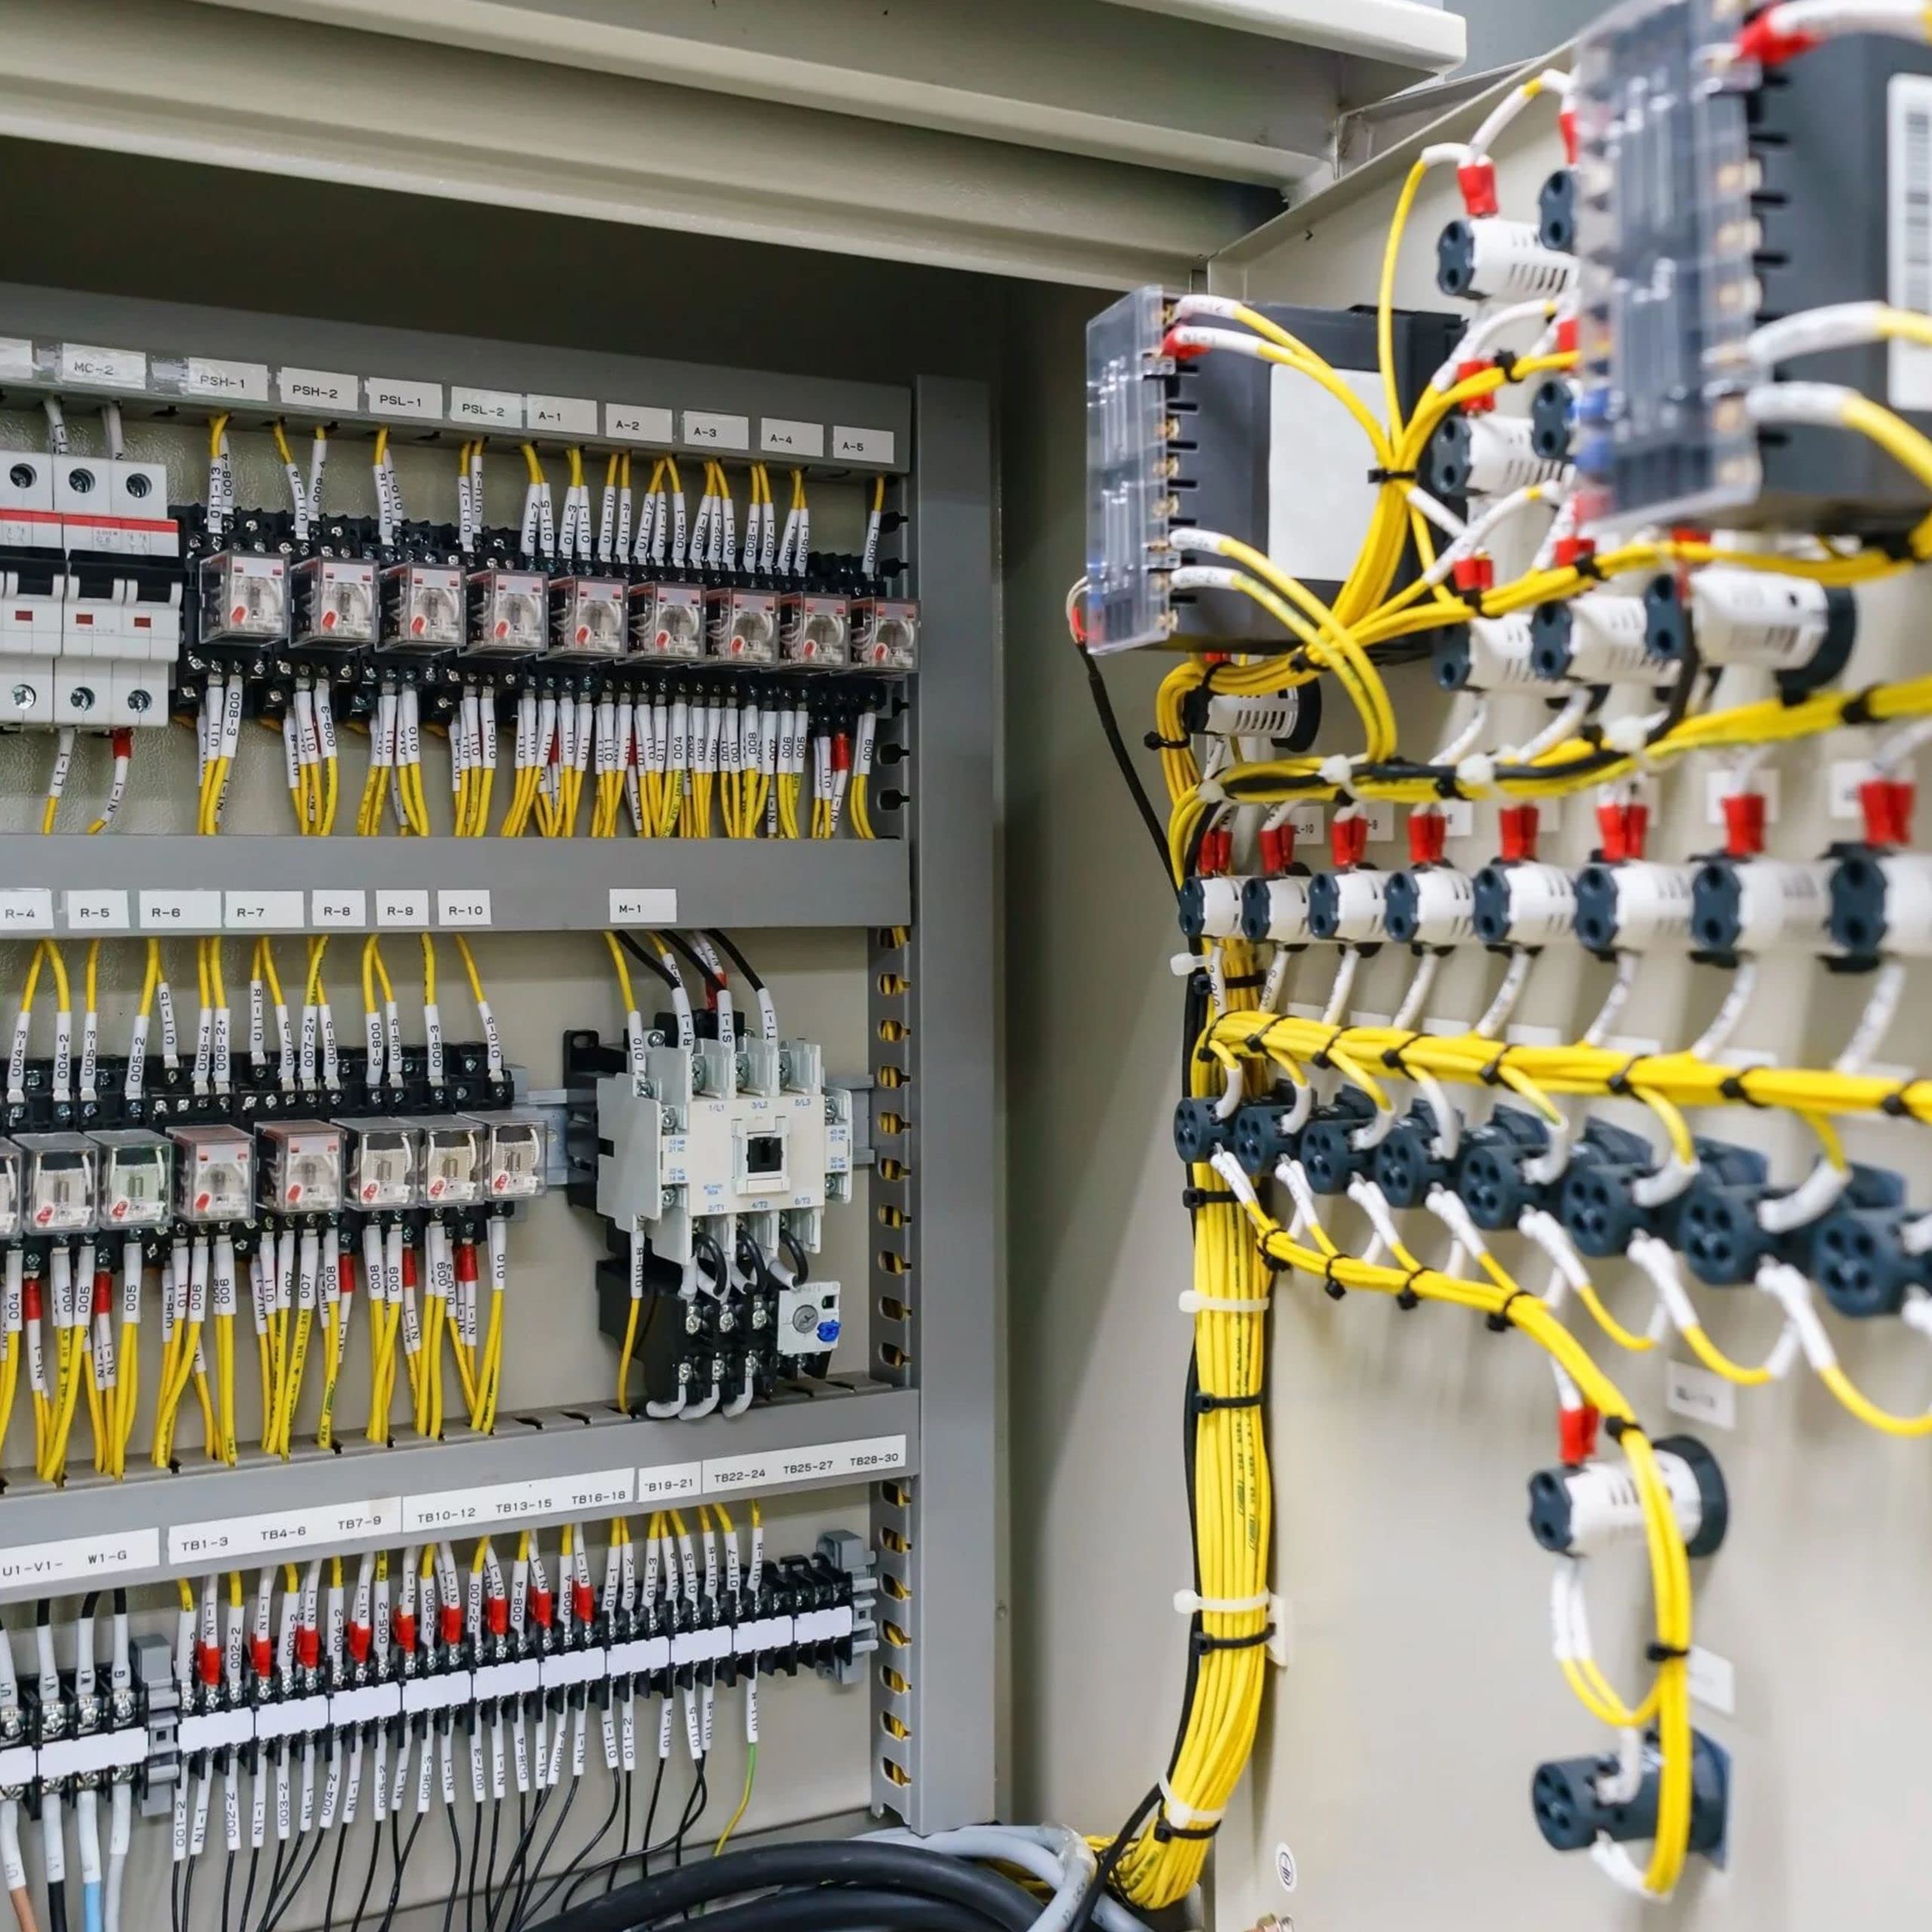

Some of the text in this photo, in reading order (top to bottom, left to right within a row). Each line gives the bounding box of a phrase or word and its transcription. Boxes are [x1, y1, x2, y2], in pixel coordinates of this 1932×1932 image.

[74, 361, 114, 376] MC-2
[199, 374, 246, 389] PSH-1
[292, 383, 338, 399] PSH-2
[379, 394, 422, 408] PSL-1
[461, 403, 505, 418] PSL-2
[538, 411, 561, 423] A-1
[616, 420, 640, 431] A-2
[693, 427, 717, 438] A-3
[770, 433, 792, 445] A-4
[842, 441, 865, 452] A-5
[221, 454, 232, 497] 008-4
[387, 470, 402, 510] 010-1
[211, 466, 221, 518] 011-13
[528, 502, 539, 543] 011-7
[540, 500, 552, 541] 011-5
[564, 504, 577, 545] 011-3
[580, 505, 590, 543] 011-1
[694, 512, 709, 549] 003-1
[727, 518, 735, 555] 001-1
[746, 519, 758, 558] 008-1
[765, 518, 774, 558] 007-1
[226, 692, 240, 737] 008-3
[304, 728, 315, 751] 011
[408, 726, 418, 752] 010
[471, 733, 479, 755] 011
[487, 720, 496, 759] 010-1
[605, 739, 614, 761] 011
[656, 740, 665, 761] 011
[674, 736, 683, 759] 004
[731, 742, 739, 763] 001
[749, 731, 757, 755] 008
[782, 737, 791, 758] 006
[796, 736, 805, 758] 005
[54, 752, 69, 786] L1-1
[108, 782, 123, 812] N1-1
[5, 908, 35, 918] R-4
[80, 907, 110, 918] R-5
[152, 907, 181, 918] R-6
[236, 907, 265, 918] R-7
[324, 906, 350, 917] R-8
[387, 906, 414, 916] R-9
[448, 906, 483, 916] R-10
[619, 903, 641, 913] M-1
[681, 1014, 691, 1046] R1-1
[722, 1012, 732, 1043] S1-1
[764, 1009, 777, 1040] T1-1
[11, 1030, 26, 1077] 004-3
[58, 1033, 69, 1079] 004-2
[85, 1031, 96, 1076] 005-3
[304, 1017, 315, 1067] 007-2+
[371, 1022, 381, 1066] 008-3
[633, 1037, 645, 1060] 010
[131, 1037, 146, 1082] 005-2
[327, 1265, 337, 1291] 008
[370, 1265, 380, 1289] 008
[389, 1266, 399, 1292] 009
[437, 1261, 447, 1287] 009
[497, 1254, 505, 1278] 010
[78, 1285, 91, 1314] 005
[126, 1284, 136, 1312] 005
[177, 1283, 187, 1308] 011
[191, 1284, 202, 1310] 006
[221, 1278, 229, 1304] 006
[302, 1274, 312, 1298] 007
[8, 1292, 20, 1320] 004
[468, 1305, 476, 1335] N1-1
[407, 1309, 418, 1340] N1-1
[714, 1453, 899, 1484] TB22-24 TB25-27 TB28-30
[645, 1478, 693, 1492] B19-21
[417, 1491, 626, 1524] TB10-12 TB13-15 TB16-18
[181, 1517, 382, 1552] TB1-3 TB4-6 TB7-9
[2, 1550, 128, 1578] U1-V1- W1-G
[534, 1558, 547, 1589] N1-1
[577, 1552, 588, 1583] N1-1
[648, 1558, 657, 1598] 011-3
[685, 1553, 697, 1593] 011-5
[728, 1549, 738, 1587] 011-7
[447, 1571, 457, 1602] N1-1
[491, 1564, 503, 1596] N1-1
[606, 1568, 618, 1607] 011-1
[260, 1596, 269, 1630] N1-1
[308, 1590, 316, 1623] N1-1
[359, 1586, 368, 1617] N1-1
[513, 1581, 524, 1622] 008-4
[206, 1601, 214, 1635] N1-1
[379, 1601, 388, 1644] 005-2
[231, 1627, 241, 1669] 002-2
[604, 1720, 617, 1758] 011-1
[623, 1718, 634, 1759] 011-2
[396, 1768, 408, 1798] N1-1
[445, 1758, 453, 1790] N1-1
[474, 1748, 484, 1789] 007-3
[279, 1782, 289, 1826] 003-2
[305, 1788, 314, 1819] N1-1
[322, 1774, 337, 1816] 004-2
[347, 1780, 359, 1811] N1-1
[176, 1801, 186, 1847] 001-2
[195, 1808, 207, 1843] N1-1
[227, 1792, 235, 1837] 002-2
[255, 1802, 263, 1835] N1-1
